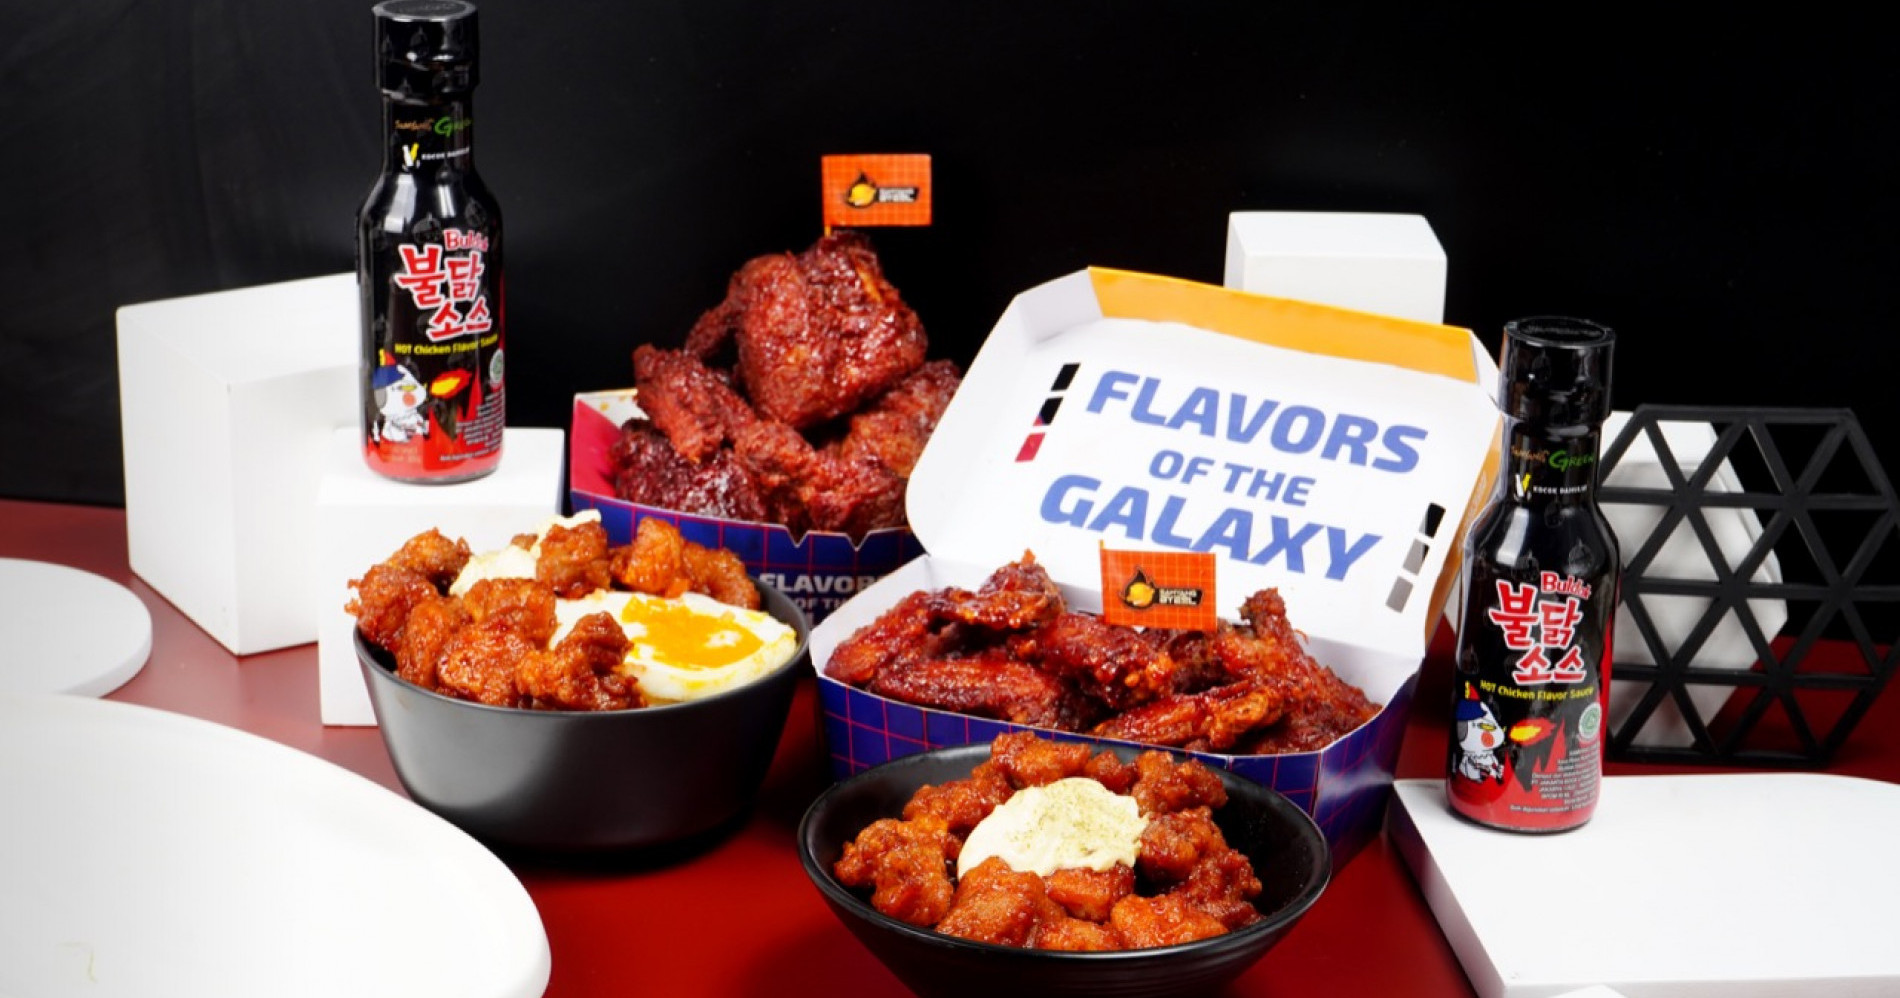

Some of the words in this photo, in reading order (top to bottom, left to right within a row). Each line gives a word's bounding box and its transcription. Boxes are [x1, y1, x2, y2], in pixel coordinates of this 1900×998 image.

[395, 244, 485, 310] 불닭
[426, 296, 494, 341] 소스
[414, 344, 452, 355] Chicken
[1086, 370, 1429, 474] FLAVORS
[1149, 449, 1215, 485] OF
[1223, 462, 1316, 507] THE
[1039, 474, 1383, 582] GALAXY
[1488, 579, 1584, 650] 불닭
[1498, 685, 1536, 699] Chicken
[1537, 690, 1569, 701] Flavor
[1512, 643, 1587, 685] 소스
